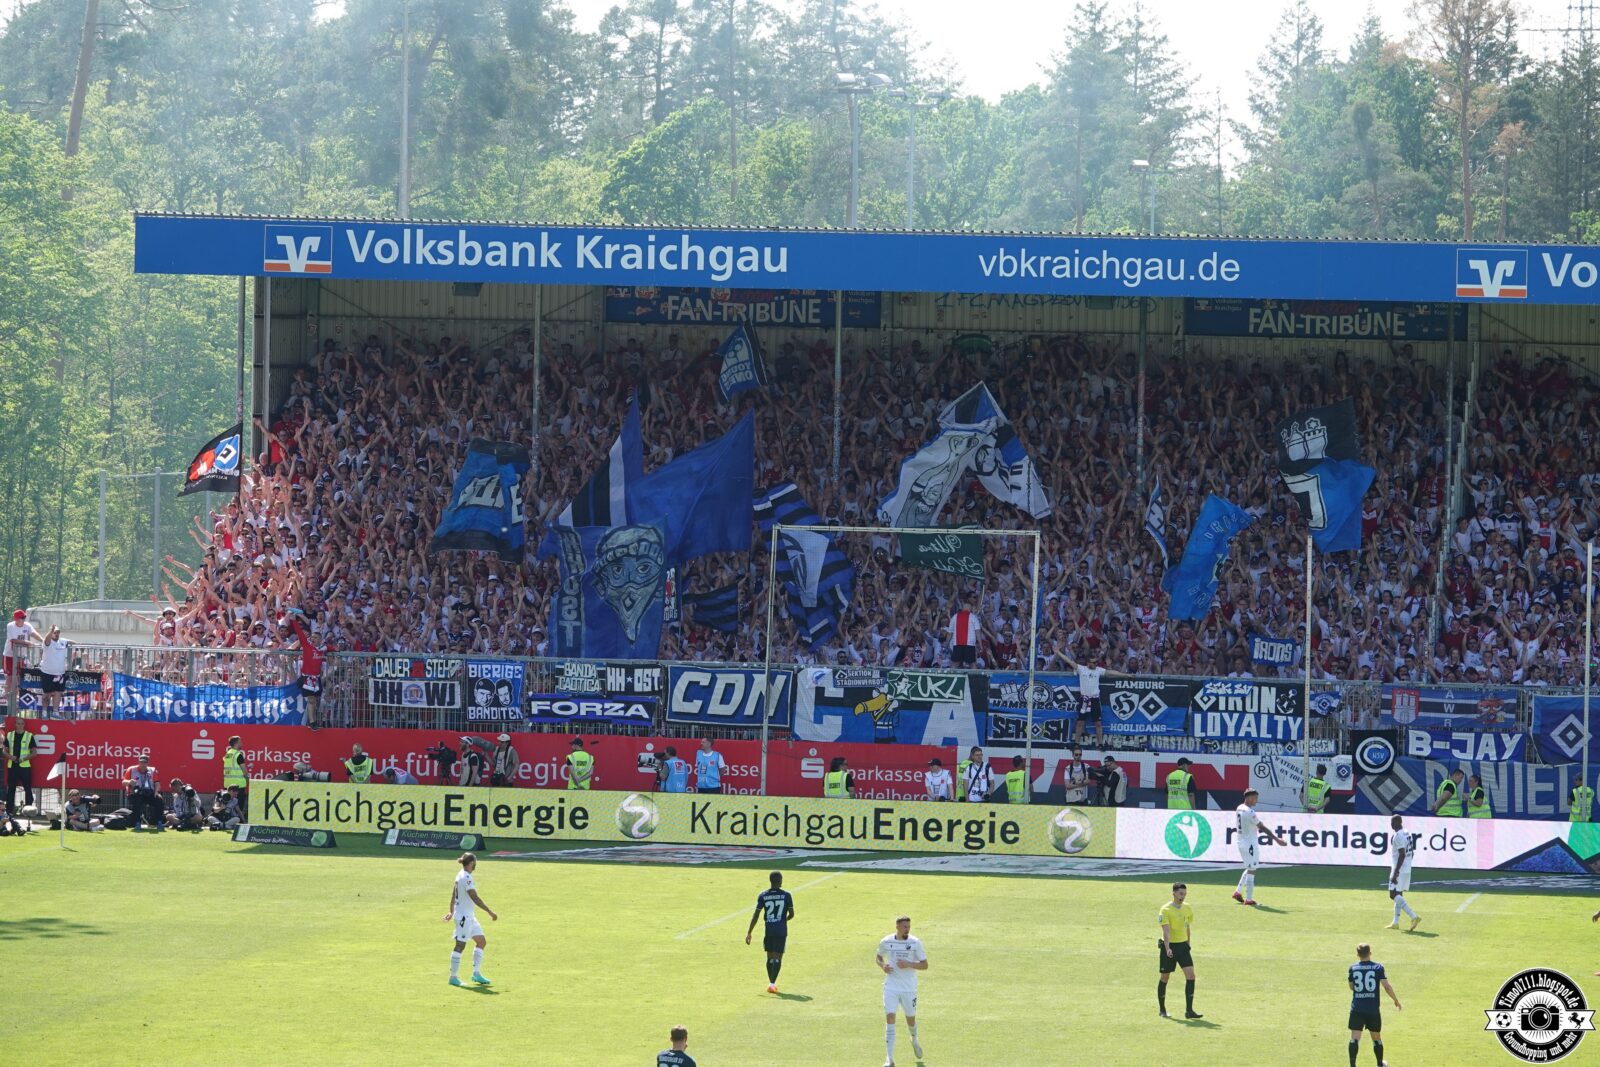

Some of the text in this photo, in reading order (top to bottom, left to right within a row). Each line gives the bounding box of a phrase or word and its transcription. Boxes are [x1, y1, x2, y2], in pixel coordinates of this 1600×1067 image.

[345, 228, 789, 281] Volksbank Kraichgau
[978, 250, 1241, 288] vbkraichgau.de
[1541, 252, 1598, 287] Vo
[667, 295, 821, 323] FAN-TRIBÜNE
[1248, 307, 1416, 336] FAN-TRIBÜNE
[375, 658, 411, 678] DAUER
[468, 664, 522, 679] BIERIGE
[607, 667, 661, 692] HH OST
[373, 681, 403, 705] HH
[672, 671, 787, 718] CDN
[1115, 680, 1165, 690] HAMBURG
[468, 706, 524, 720] BANDITEN
[531, 701, 650, 719] FORZA
[1110, 723, 1167, 733] HOOLIGANS
[1194, 712, 1303, 741] LOYALTY
[66, 741, 151, 760] Sparkasse
[1149, 736, 1201, 751] VORSTADT
[1408, 729, 1523, 761] B-JAY
[265, 787, 590, 836] KraichgauEnergie
[691, 800, 1020, 850] KraichgauEnergie
[765, 899, 785, 919] 27
[1353, 970, 1376, 992] 36
